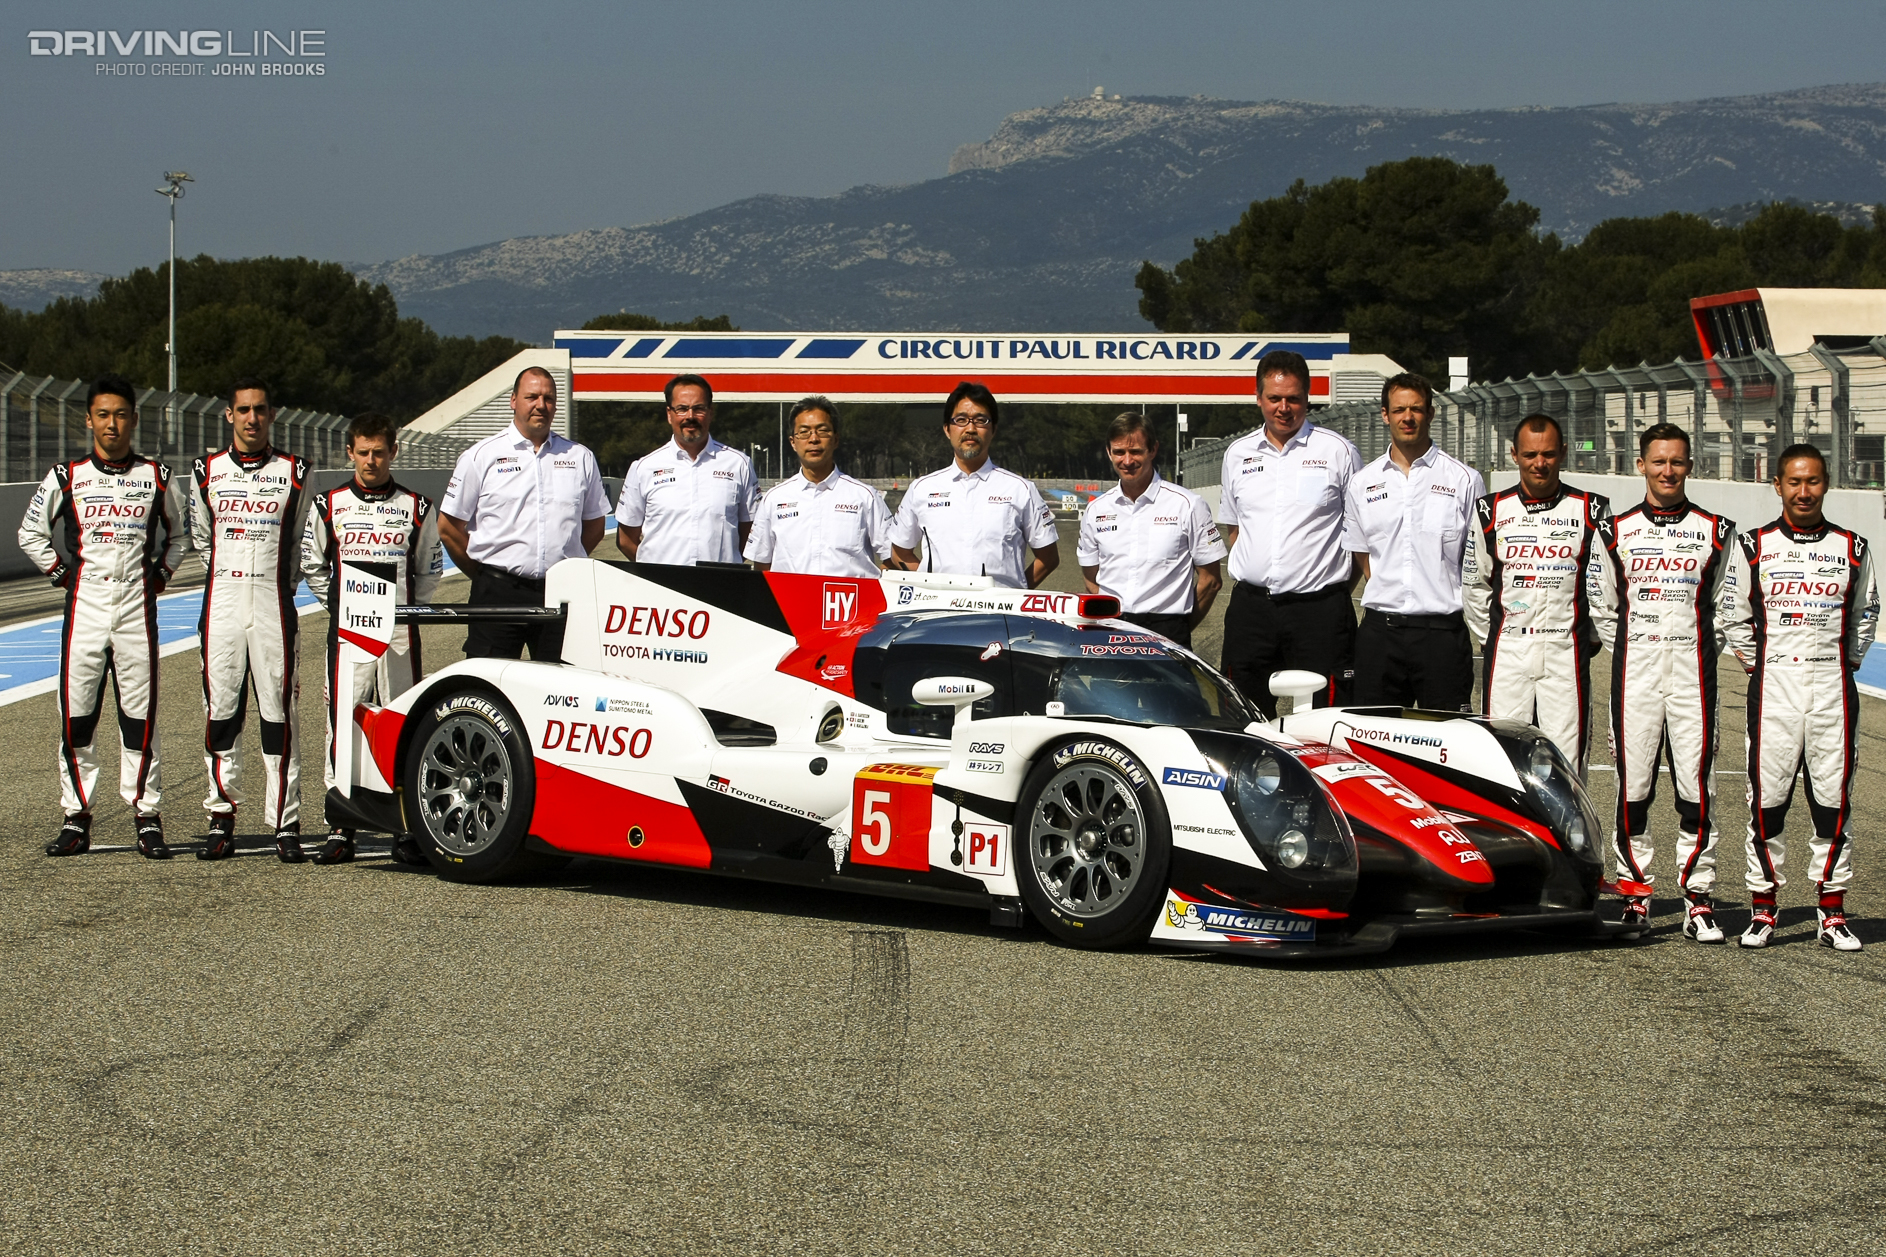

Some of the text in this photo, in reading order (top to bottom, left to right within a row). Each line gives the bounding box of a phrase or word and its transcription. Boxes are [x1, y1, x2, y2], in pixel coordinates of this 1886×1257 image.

[878, 339, 1220, 360] CIRCUIT PAUL RICARD
[1242, 467, 1257, 475] Mobil
[74, 479, 92, 490] ZENT
[118, 479, 142, 488] Mobil
[211, 473, 228, 483] ZENT
[252, 474, 277, 483] Mobil
[1431, 485, 1456, 494] DENSO
[1367, 494, 1382, 504] Mobil
[85, 505, 145, 518] DENSO
[218, 500, 279, 513] DENSO
[334, 506, 352, 515] ZENT
[377, 506, 402, 515] Mobil
[80, 522, 111, 530] TOYOTA
[215, 516, 243, 524] TOYOTA
[1542, 518, 1568, 526] Mobil
[93, 535, 113, 543] GR
[224, 532, 243, 540] GR
[344, 532, 404, 545] DENSO
[1667, 529, 1694, 538] Mobil
[1506, 545, 1572, 559] DENSO
[1761, 553, 1780, 562] ZENT
[1809, 553, 1836, 562] Mobil
[1631, 558, 1697, 571] DENSO
[1513, 580, 1535, 588] GR
[1628, 575, 1659, 583] TOYOTA
[347, 580, 375, 594] Mobil
[1771, 582, 1839, 596] DENSO
[825, 591, 855, 621] HY
[966, 601, 1013, 611] AISIN AW
[1020, 594, 1073, 614] ZENT
[1765, 600, 1801, 608] TOYOTA
[350, 610, 383, 628] JTEKT
[604, 605, 710, 639] DENSO
[1780, 618, 1802, 626] GR
[603, 644, 708, 664] TOYOTA HYBRID
[1081, 645, 1165, 655] TOYOTA
[939, 685, 963, 693] Mobil
[451, 697, 509, 734] MICHELIN
[608, 706, 636, 714] SUMITOMO
[542, 720, 652, 759] DENSO
[1350, 727, 1442, 747] TOYOTA HYBRID
[969, 742, 1004, 754] RAYS
[1440, 748, 1447, 763] 5
[1073, 742, 1145, 784] MICHELIN
[868, 763, 925, 777] DHL
[1166, 771, 1222, 788] AISIN
[708, 779, 728, 792] GR
[730, 787, 767, 803] TOYOTA
[769, 800, 804, 815] GAZOO
[1364, 778, 1425, 810] 5
[860, 790, 891, 856] 5
[1174, 825, 1236, 837] MITSUBISHI ELECTRIC
[970, 832, 999, 867] P1
[1455, 850, 1486, 864] ZENT
[1207, 912, 1312, 932] MICHELIN
